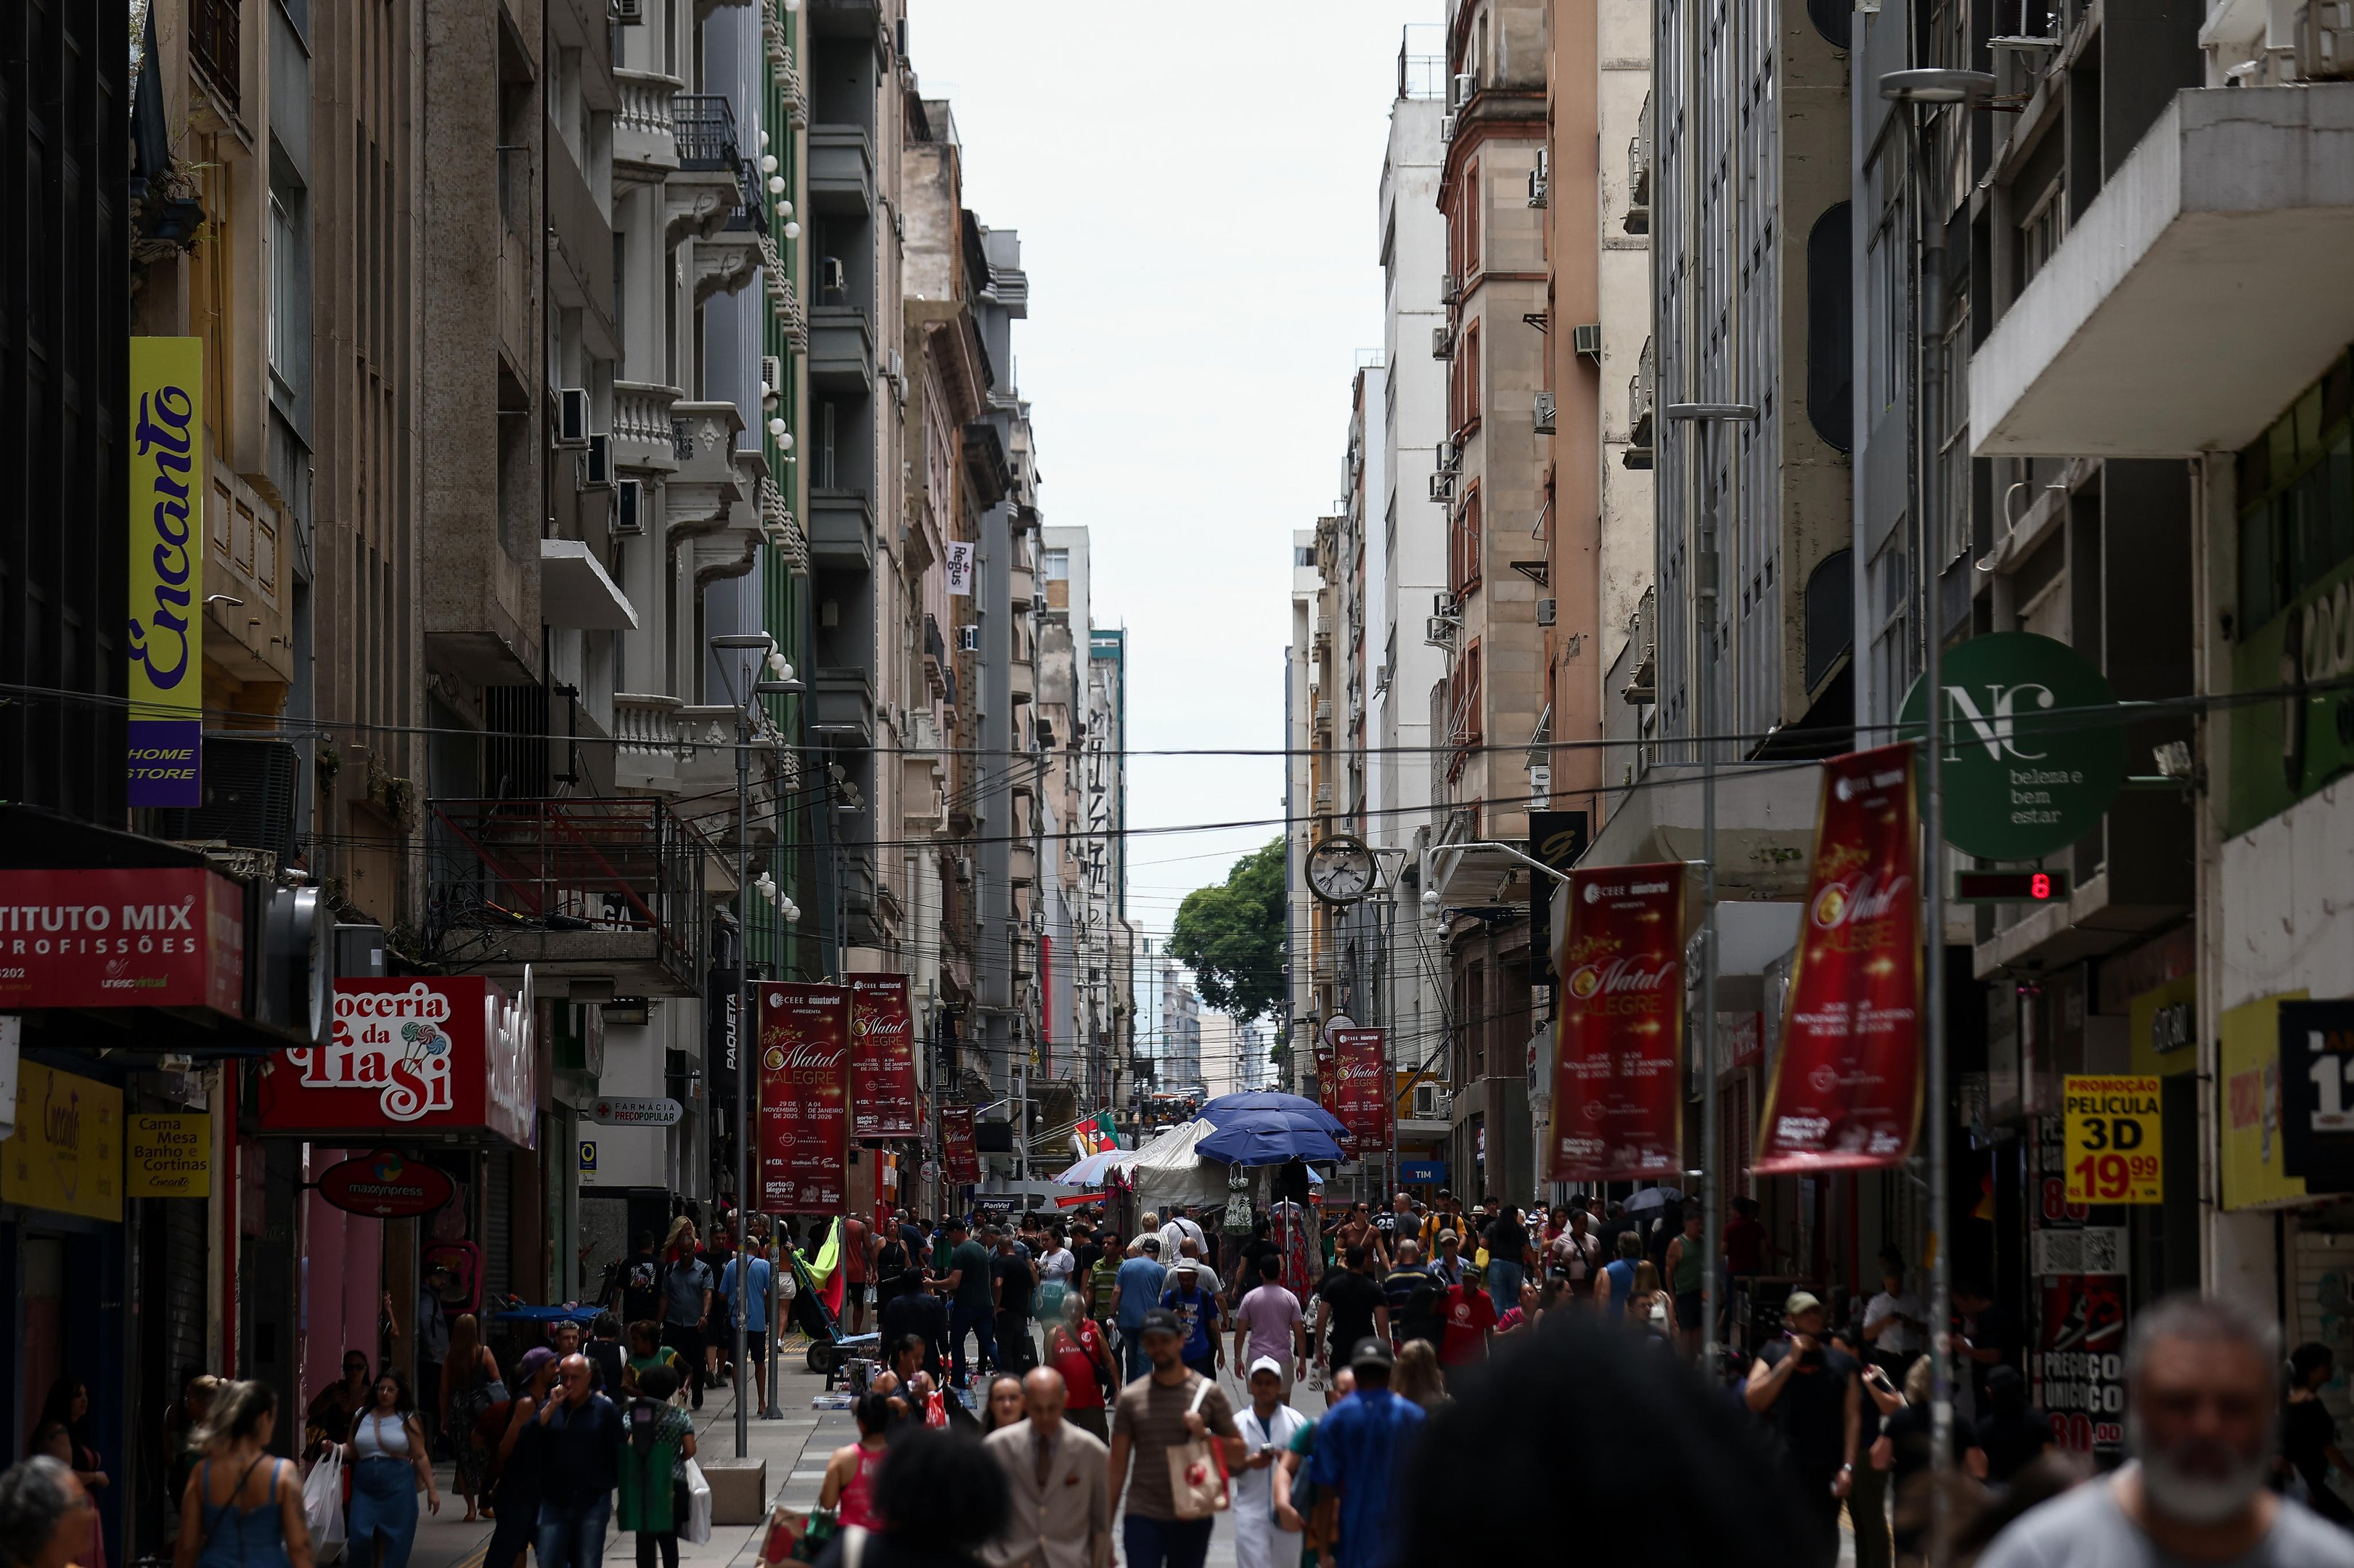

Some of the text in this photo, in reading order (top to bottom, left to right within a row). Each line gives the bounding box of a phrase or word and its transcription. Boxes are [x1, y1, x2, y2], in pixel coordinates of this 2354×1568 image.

[948, 546, 966, 585] Regus
[1940, 683, 2055, 761] NC
[128, 748, 195, 760] HOME
[2009, 768, 2083, 785] beleza e
[2011, 788, 2051, 804] bem
[2010, 808, 2062, 824] estar
[122, 905, 192, 931] MIX
[0, 935, 196, 954] ROFISSÕES
[1568, 953, 1677, 1000] Natal
[335, 988, 446, 1018] oceria
[809, 996, 840, 1005] equatorial
[361, 1023, 391, 1044] da
[852, 1015, 910, 1037] Natal
[859, 1036, 904, 1046] ALEGRE
[764, 1041, 847, 1071] Natal
[772, 1071, 836, 1085] ALEGRE
[1337, 1063, 1383, 1080] Natal
[385, 1057, 447, 1114] Si
[1342, 1078, 1378, 1087] ALEGRE
[2069, 1078, 2158, 1093] PROMOÇÃO
[615, 1102, 674, 1111] FARMÁCIA
[139, 1118, 181, 1130] Cama
[615, 1111, 674, 1121] PREÇOPOPULAR
[158, 1132, 197, 1143] Mesa
[2082, 1118, 2143, 1150] 3D
[134, 1146, 197, 1157] Banho e
[144, 1159, 207, 1171] Cortinas
[150, 1175, 189, 1188] Encanto
[1376, 1218, 1394, 1230] 25
